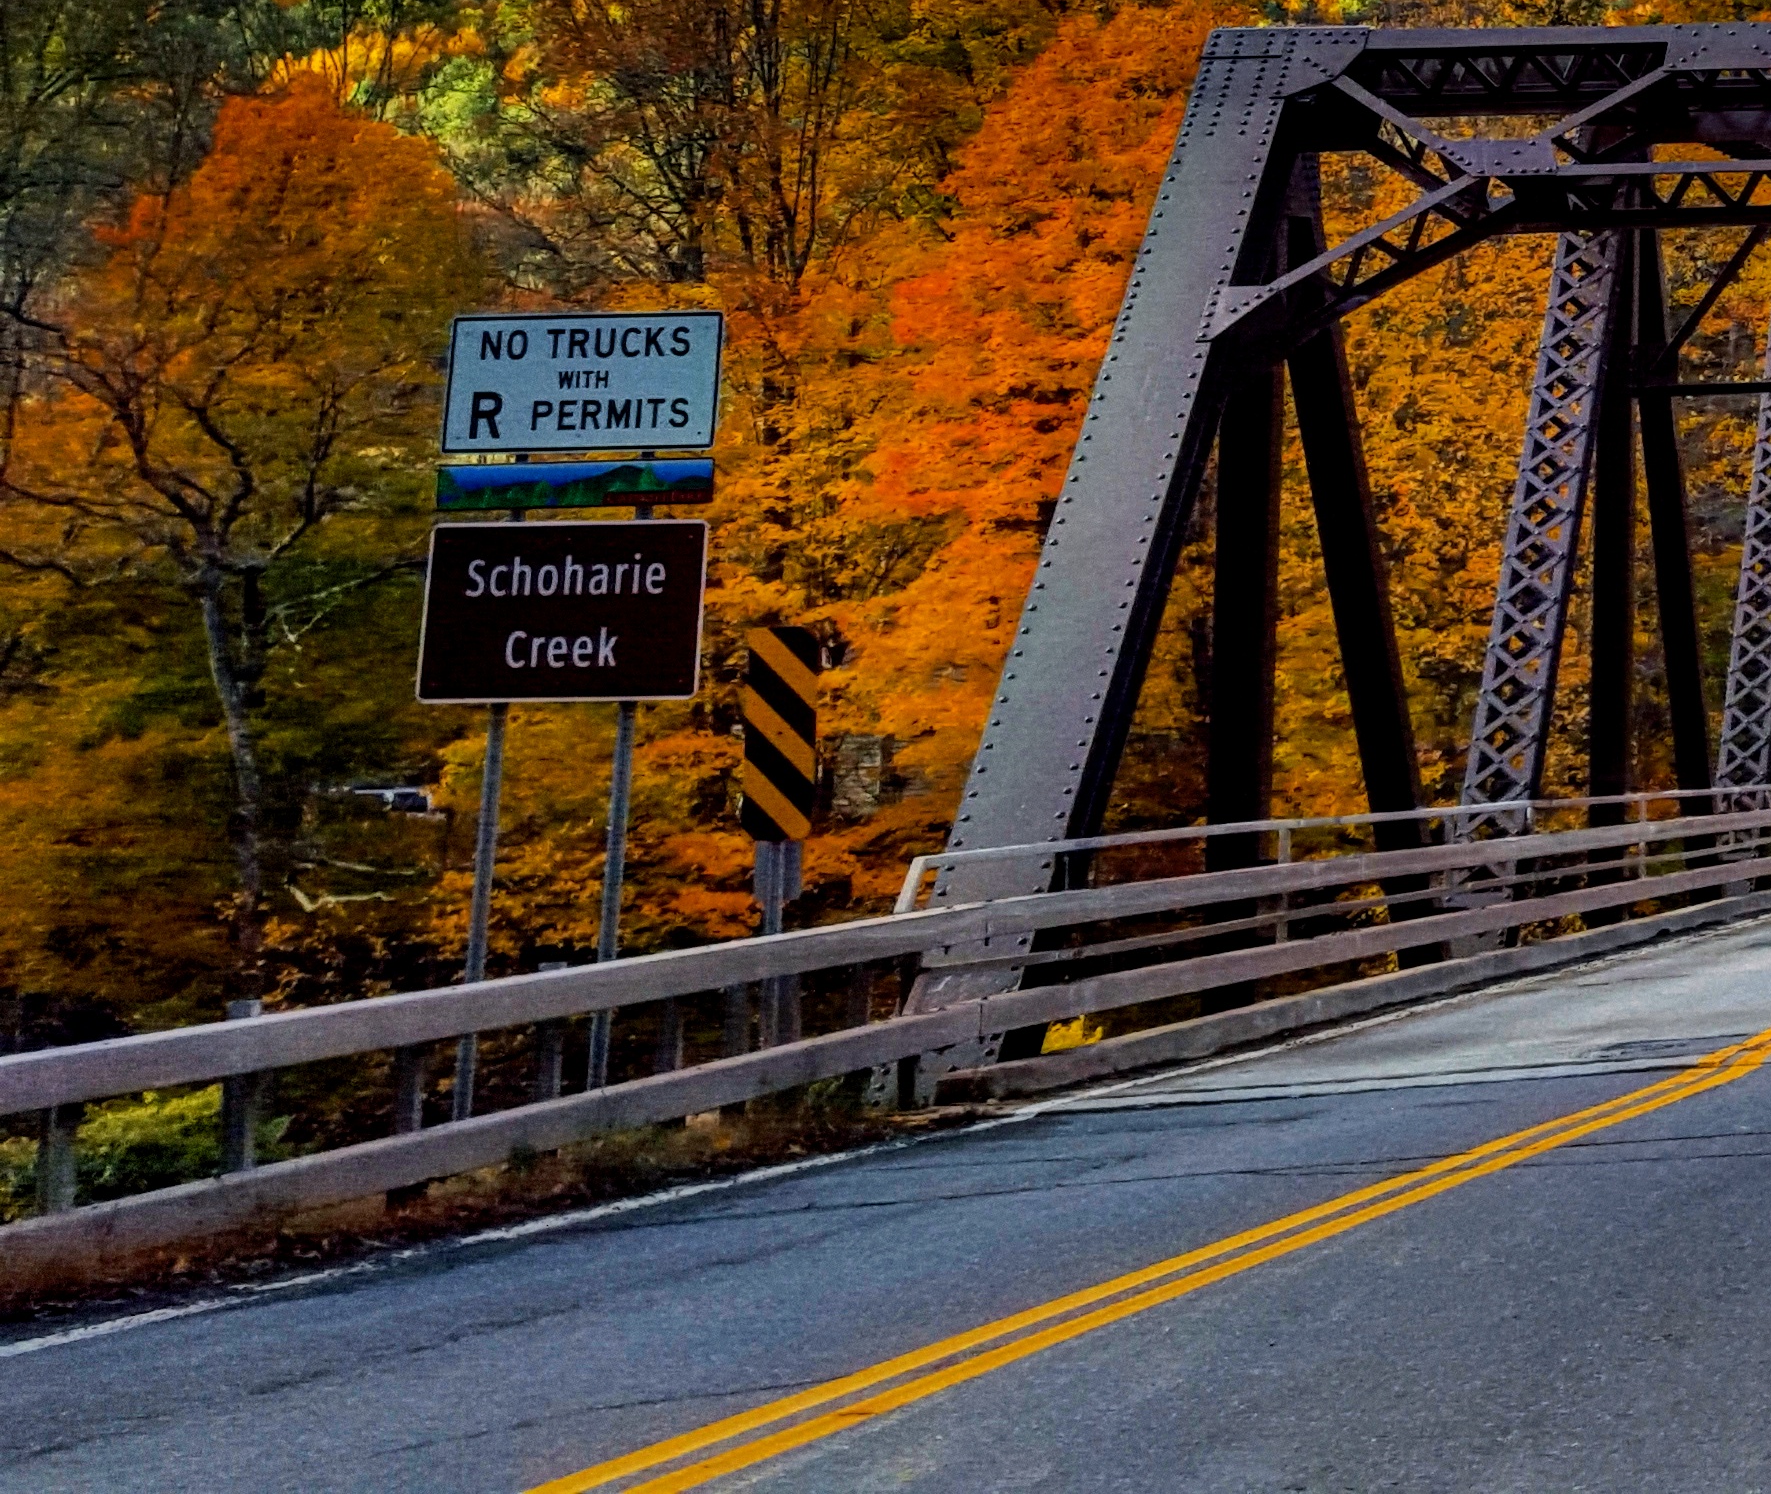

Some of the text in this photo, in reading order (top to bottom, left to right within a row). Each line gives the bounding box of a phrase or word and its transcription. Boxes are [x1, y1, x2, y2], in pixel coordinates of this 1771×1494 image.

[480, 327, 691, 360] NO TRUCKS
[558, 370, 609, 389] WITH
[469, 391, 690, 439] R PERMITS
[465, 553, 667, 598] Schoharie
[505, 627, 618, 669] Creek
